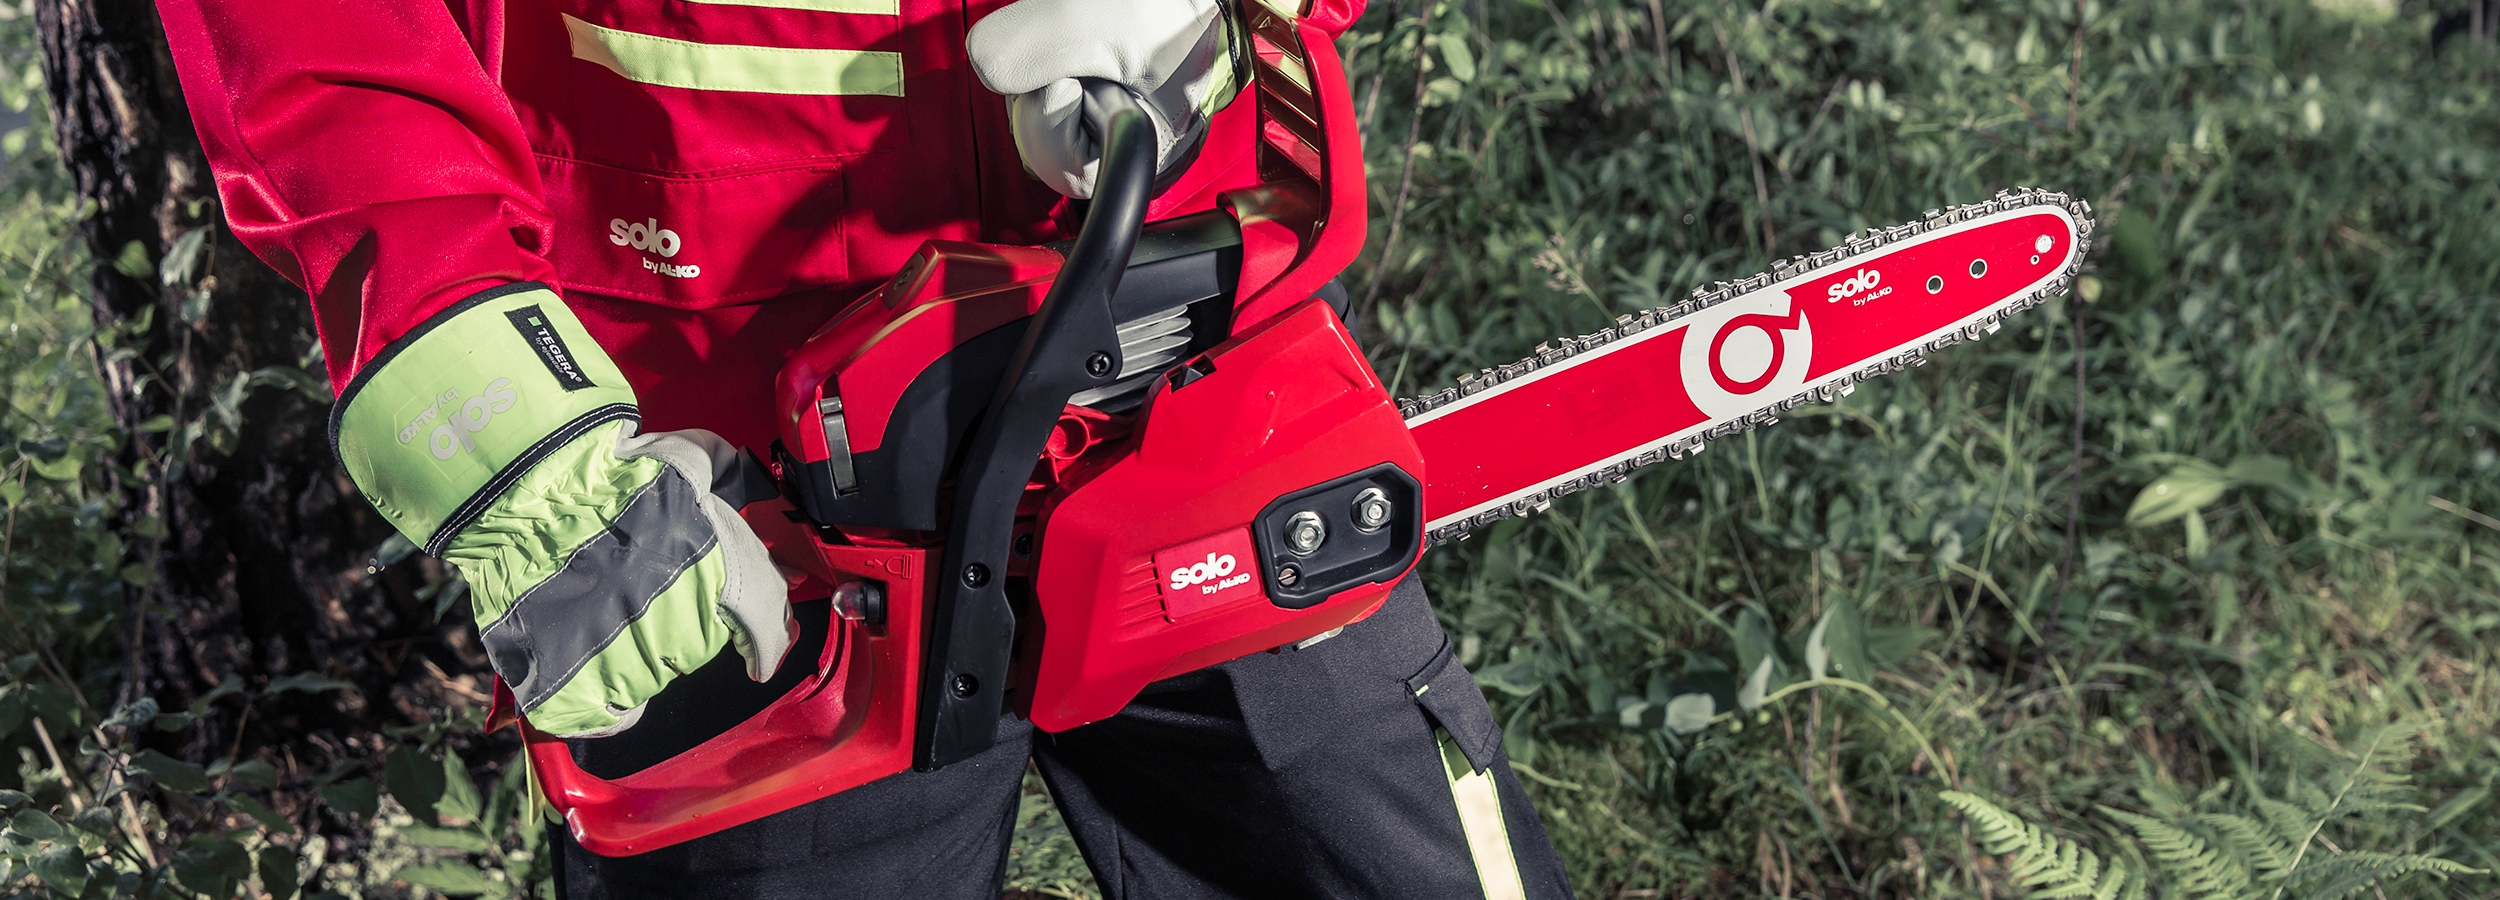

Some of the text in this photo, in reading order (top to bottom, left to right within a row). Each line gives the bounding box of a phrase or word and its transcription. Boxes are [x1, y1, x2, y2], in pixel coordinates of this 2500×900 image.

[609, 217, 681, 257] solo
[642, 256, 658, 274] by
[1828, 268, 1881, 303] solo
[1853, 297, 1866, 307] by
[535, 336, 544, 347] by
[436, 386, 460, 409] by
[429, 376, 517, 461] solo
[1170, 552, 1236, 590] solo
[1201, 583, 1218, 595] by
